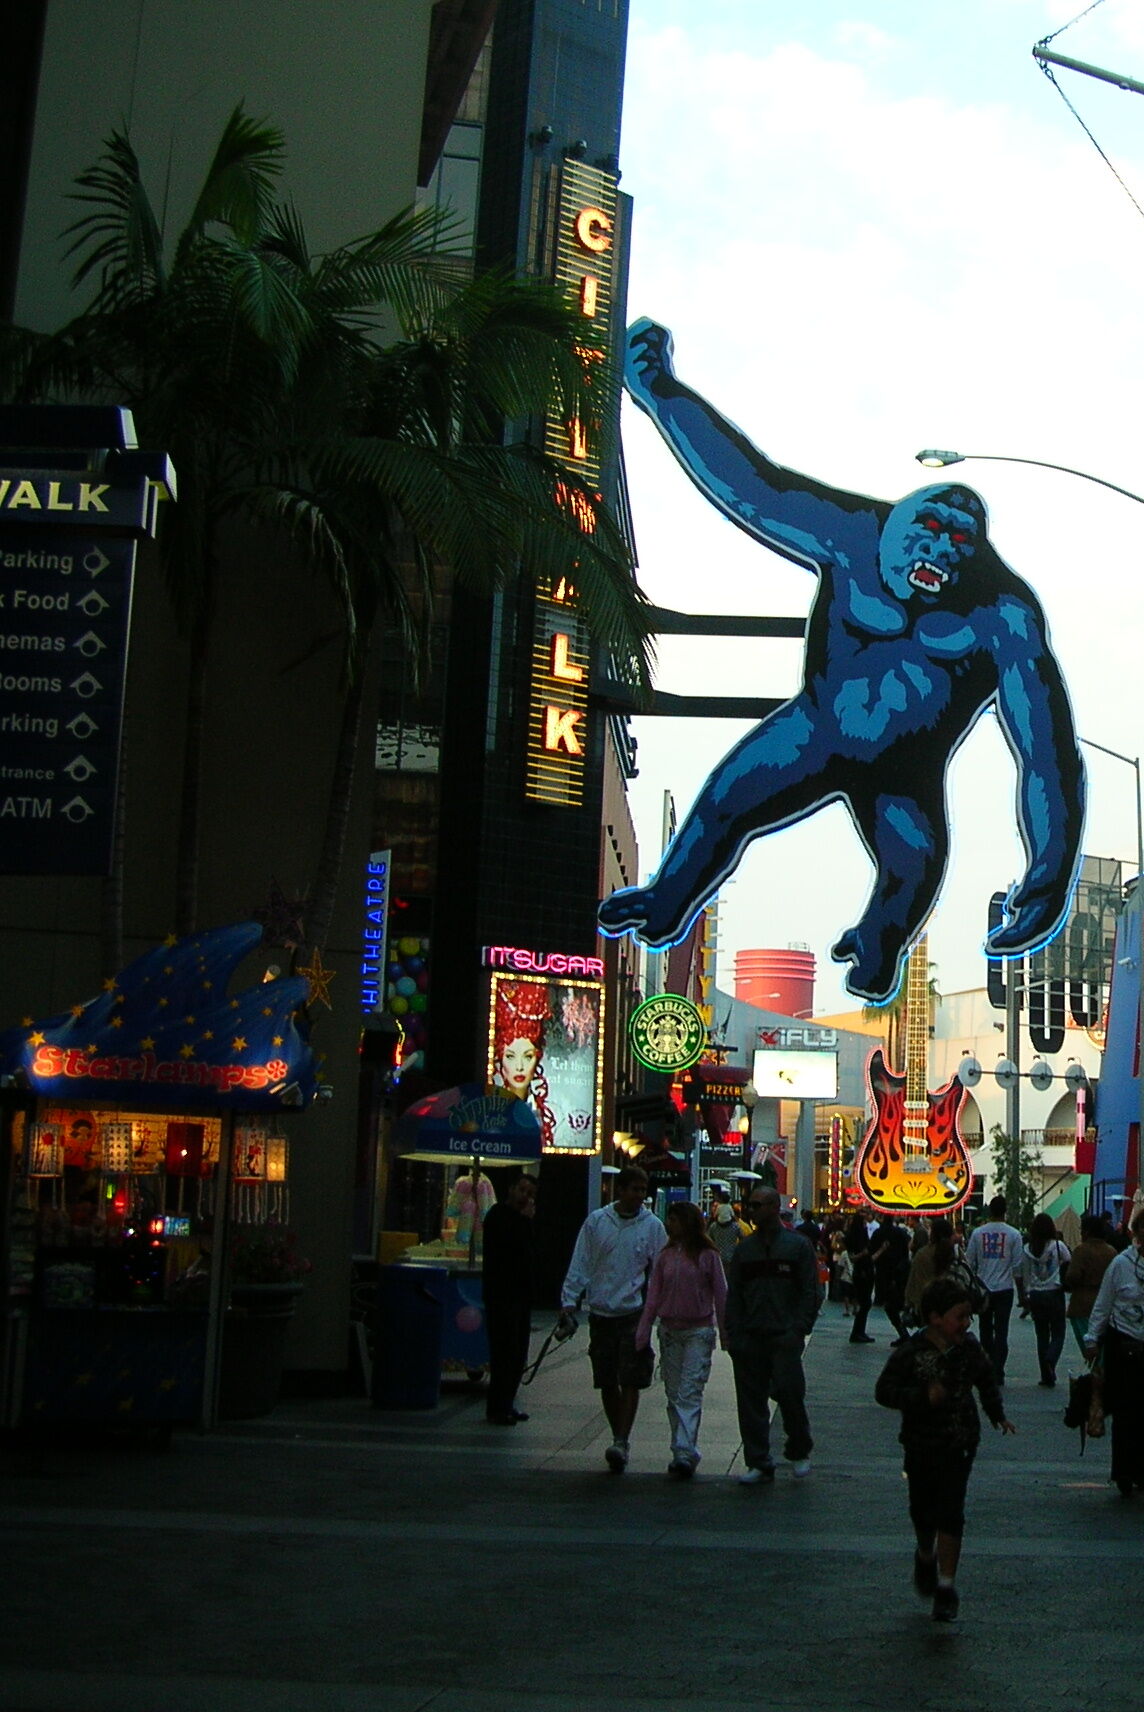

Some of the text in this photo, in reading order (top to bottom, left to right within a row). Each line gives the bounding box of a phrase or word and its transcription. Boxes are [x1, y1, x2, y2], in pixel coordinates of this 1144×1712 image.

[544, 207, 611, 756] CITYLK
[0, 546, 74, 575] arking
[13, 590, 70, 611] Food
[0, 672, 62, 693] ooms
[0, 797, 52, 819] ATM
[362, 861, 387, 1013] HITHEATRE
[637, 1001, 699, 1032] STARBUCKS
[642, 1044, 691, 1064] COFFEE
[33, 1046, 270, 1093] Starlamps
[449, 1137, 512, 1154] Ice Cream
